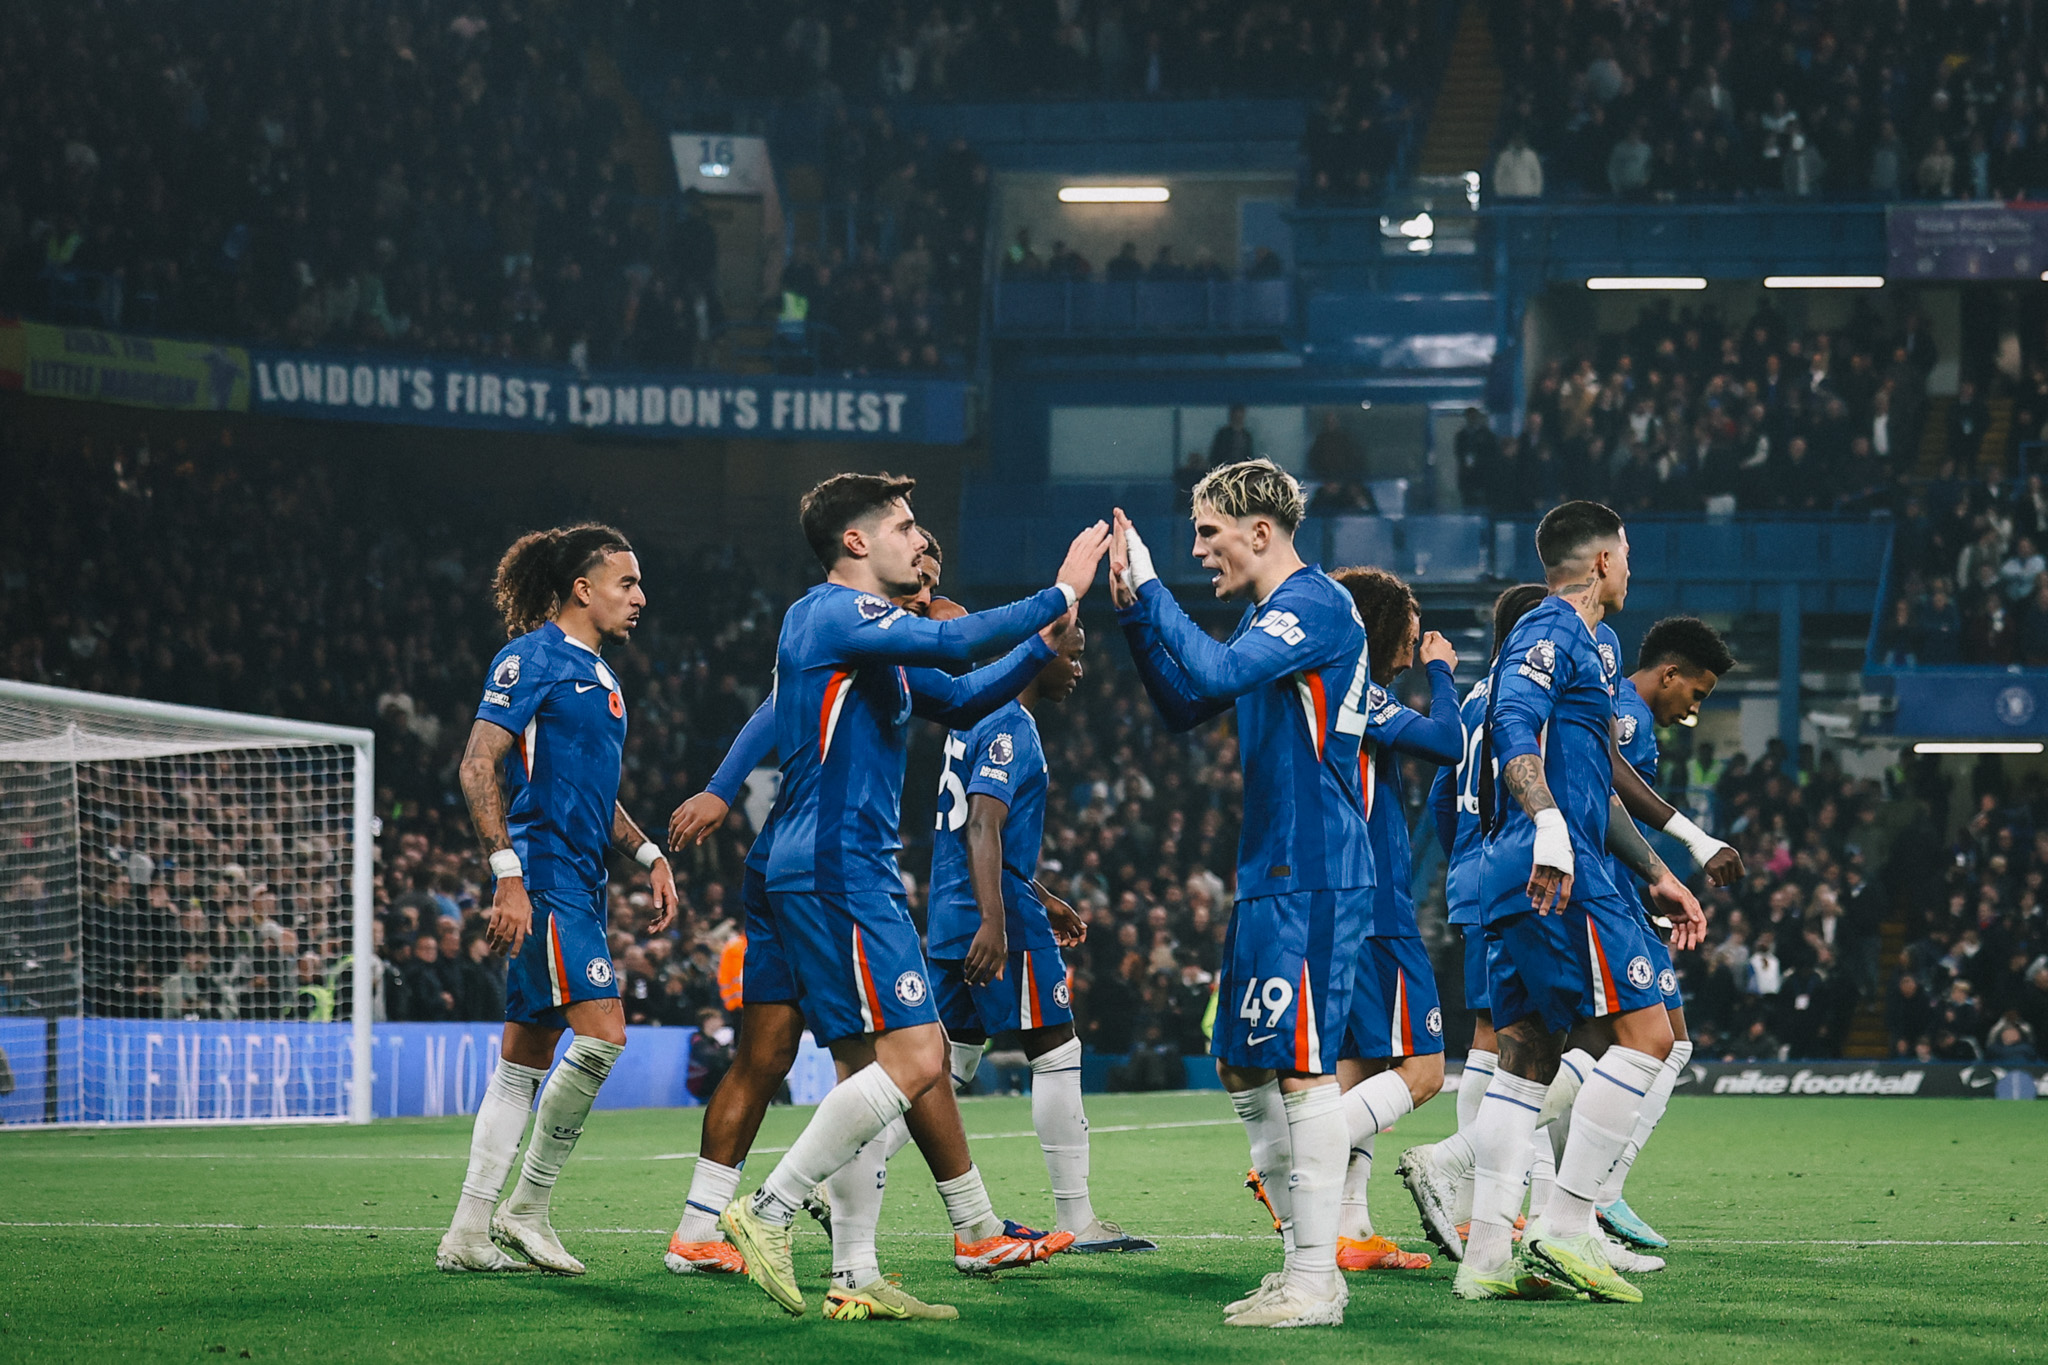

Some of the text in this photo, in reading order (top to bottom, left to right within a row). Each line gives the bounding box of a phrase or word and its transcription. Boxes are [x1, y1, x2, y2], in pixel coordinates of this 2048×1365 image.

[699, 139, 735, 165] 16
[256, 361, 908, 433] LONDON'S FIRST, LONDON'S FINEST
[1256, 610, 1305, 645] FPT
[1240, 976, 1294, 1029] 49
[104, 1033, 316, 1121] MEMBERS
[423, 1033, 502, 1116] MOR
[1714, 1069, 1926, 1095] nike football
